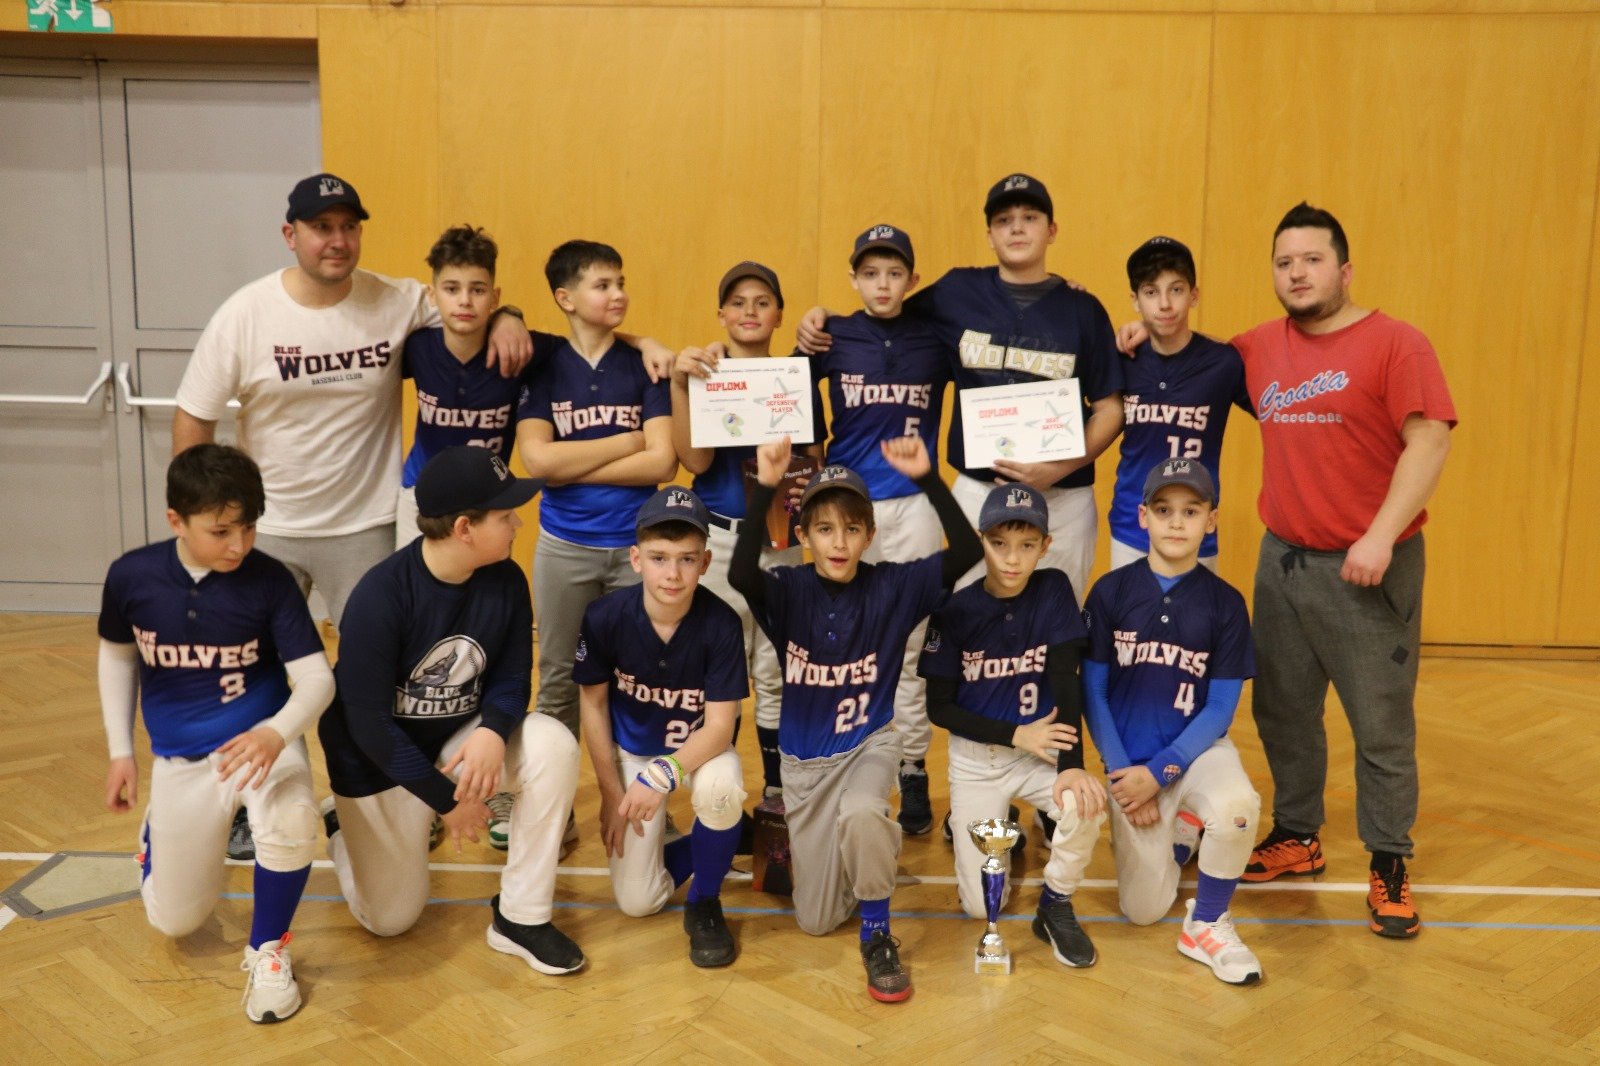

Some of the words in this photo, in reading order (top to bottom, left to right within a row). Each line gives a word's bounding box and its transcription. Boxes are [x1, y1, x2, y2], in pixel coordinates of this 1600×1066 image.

[274, 345, 301, 355] BLUE
[274, 341, 390, 381] WOLVES
[960, 341, 1076, 380] WOLVES
[311, 375, 344, 385] BASEBALL
[706, 381, 747, 392] DIPLOMA
[841, 373, 864, 384] BLUE
[841, 383, 932, 410] WOLVES
[1258, 370, 1349, 422] Croatia
[419, 404, 511, 429] WOLVES
[552, 405, 641, 437] WOLVES
[979, 406, 1018, 418] DIPLOMA
[1123, 402, 1210, 431] WOLVES
[904, 417, 920, 437] 5
[1167, 435, 1203, 459] 12
[1114, 630, 1137, 641] BLUE
[136, 639, 259, 668] WOLVES
[962, 645, 1047, 681] WOLVES
[963, 650, 985, 660] BLUE
[1114, 641, 1209, 678] WOLVES
[786, 652, 878, 687] WOLVES
[220, 672, 246, 704] 3
[396, 688, 478, 715] WOLVES
[425, 686, 461, 699] BLUE
[1019, 683, 1038, 716] 9
[1174, 683, 1195, 716] 4
[835, 692, 870, 734] 21
